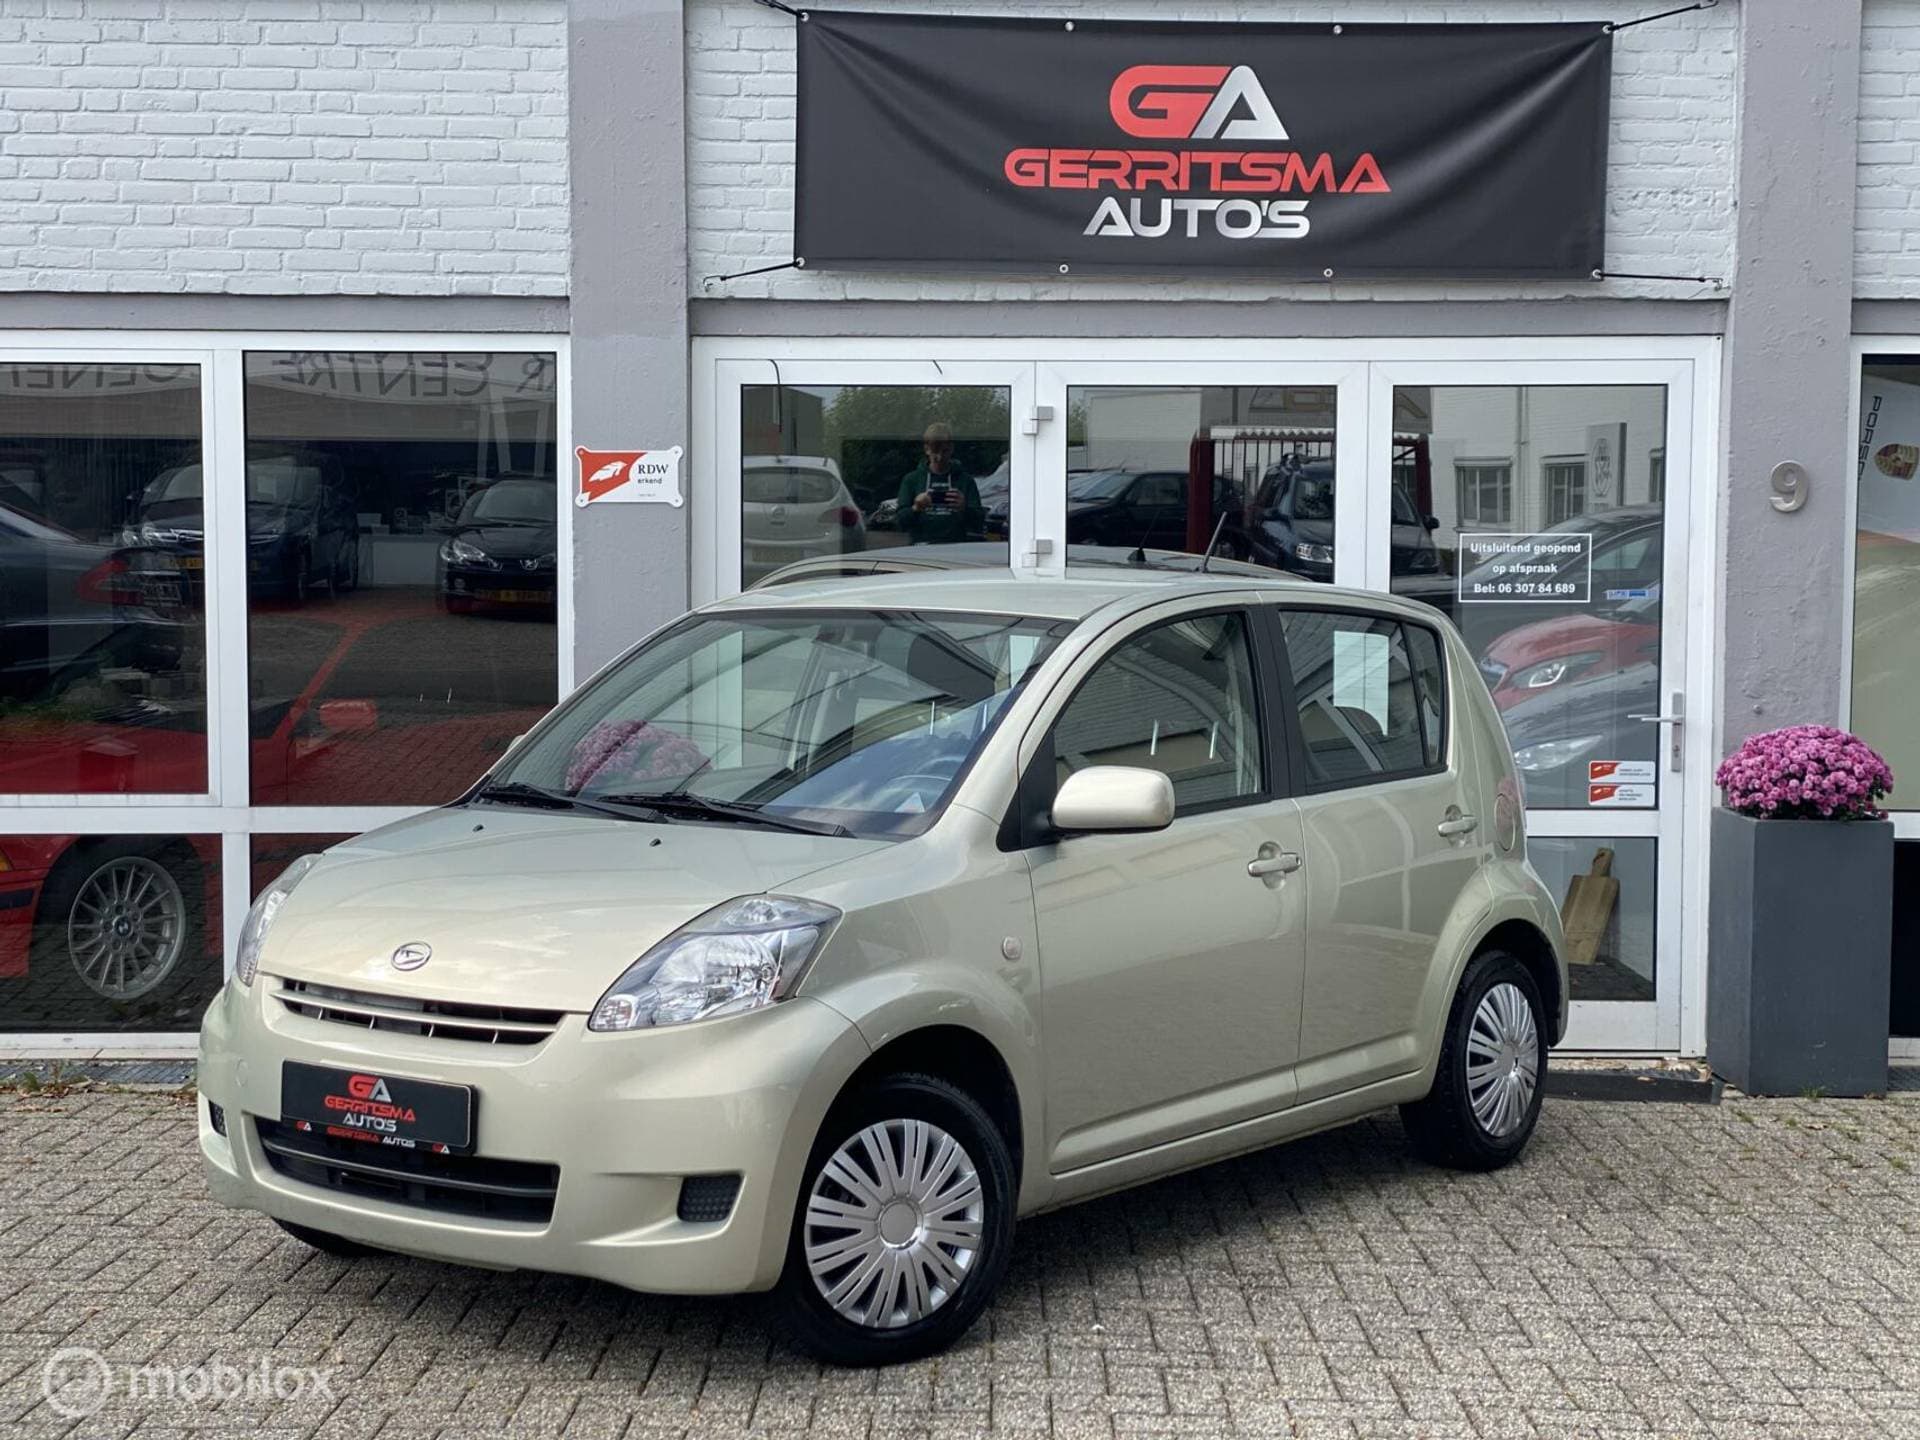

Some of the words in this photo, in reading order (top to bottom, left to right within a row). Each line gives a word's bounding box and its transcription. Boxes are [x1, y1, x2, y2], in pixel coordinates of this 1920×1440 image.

[1109, 64, 1290, 140] GA
[1004, 147, 1392, 193] GERRITSMA
[1082, 196, 1311, 239] AUTO'S
[638, 464, 668, 474] RDW
[1769, 460, 1808, 512] 9
[1470, 543, 1531, 553] Uitsluitend
[1533, 543, 1581, 556] geopend
[1492, 565, 1507, 575] op
[1509, 563, 1558, 575] afspraak
[1474, 583, 1495, 593] Bel:
[1498, 583, 1512, 593] 06
[1515, 583, 1535, 593] 307
[1538, 583, 1552, 593] 84
[1555, 583, 1576, 593] 689
[349, 1074, 392, 1102] GA
[325, 1096, 416, 1121] GERRITSMA
[343, 1112, 397, 1132] AUTO'S
